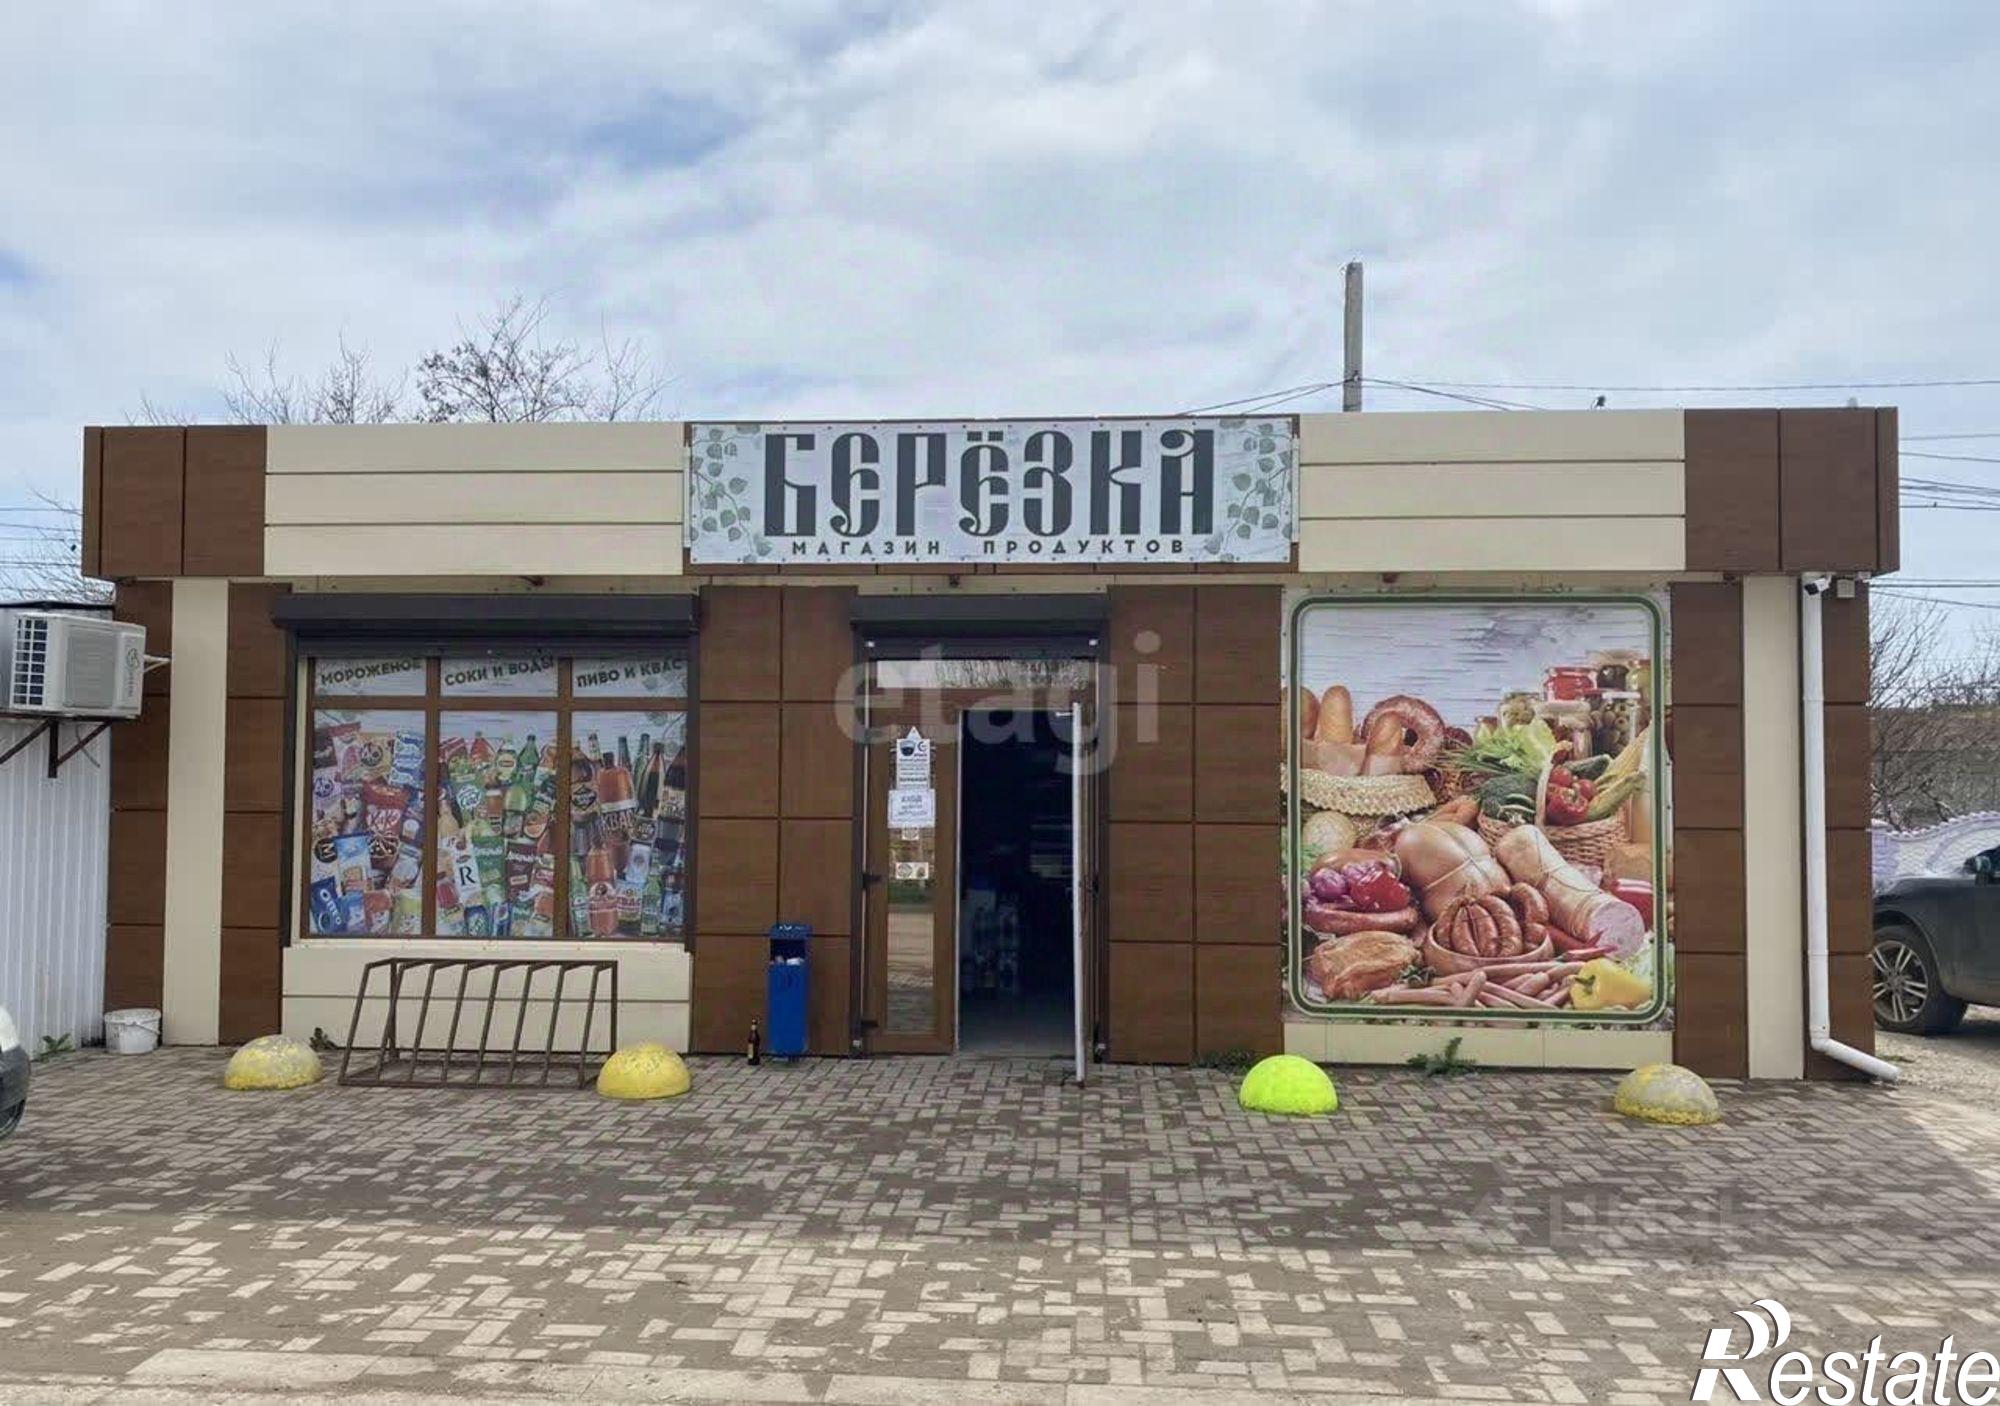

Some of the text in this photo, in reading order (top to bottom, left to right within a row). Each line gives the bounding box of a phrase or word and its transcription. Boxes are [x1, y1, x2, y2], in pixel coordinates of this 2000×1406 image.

[763, 428, 1214, 537] БЕРЁЗКА
[792, 540, 1184, 555] МАГАЗИН ПРОДУКТОВ
[444, 655, 554, 686] СОКИ И ВОДЫ
[576, 658, 682, 688] ПИВО И КВАС
[459, 866, 476, 886] R
